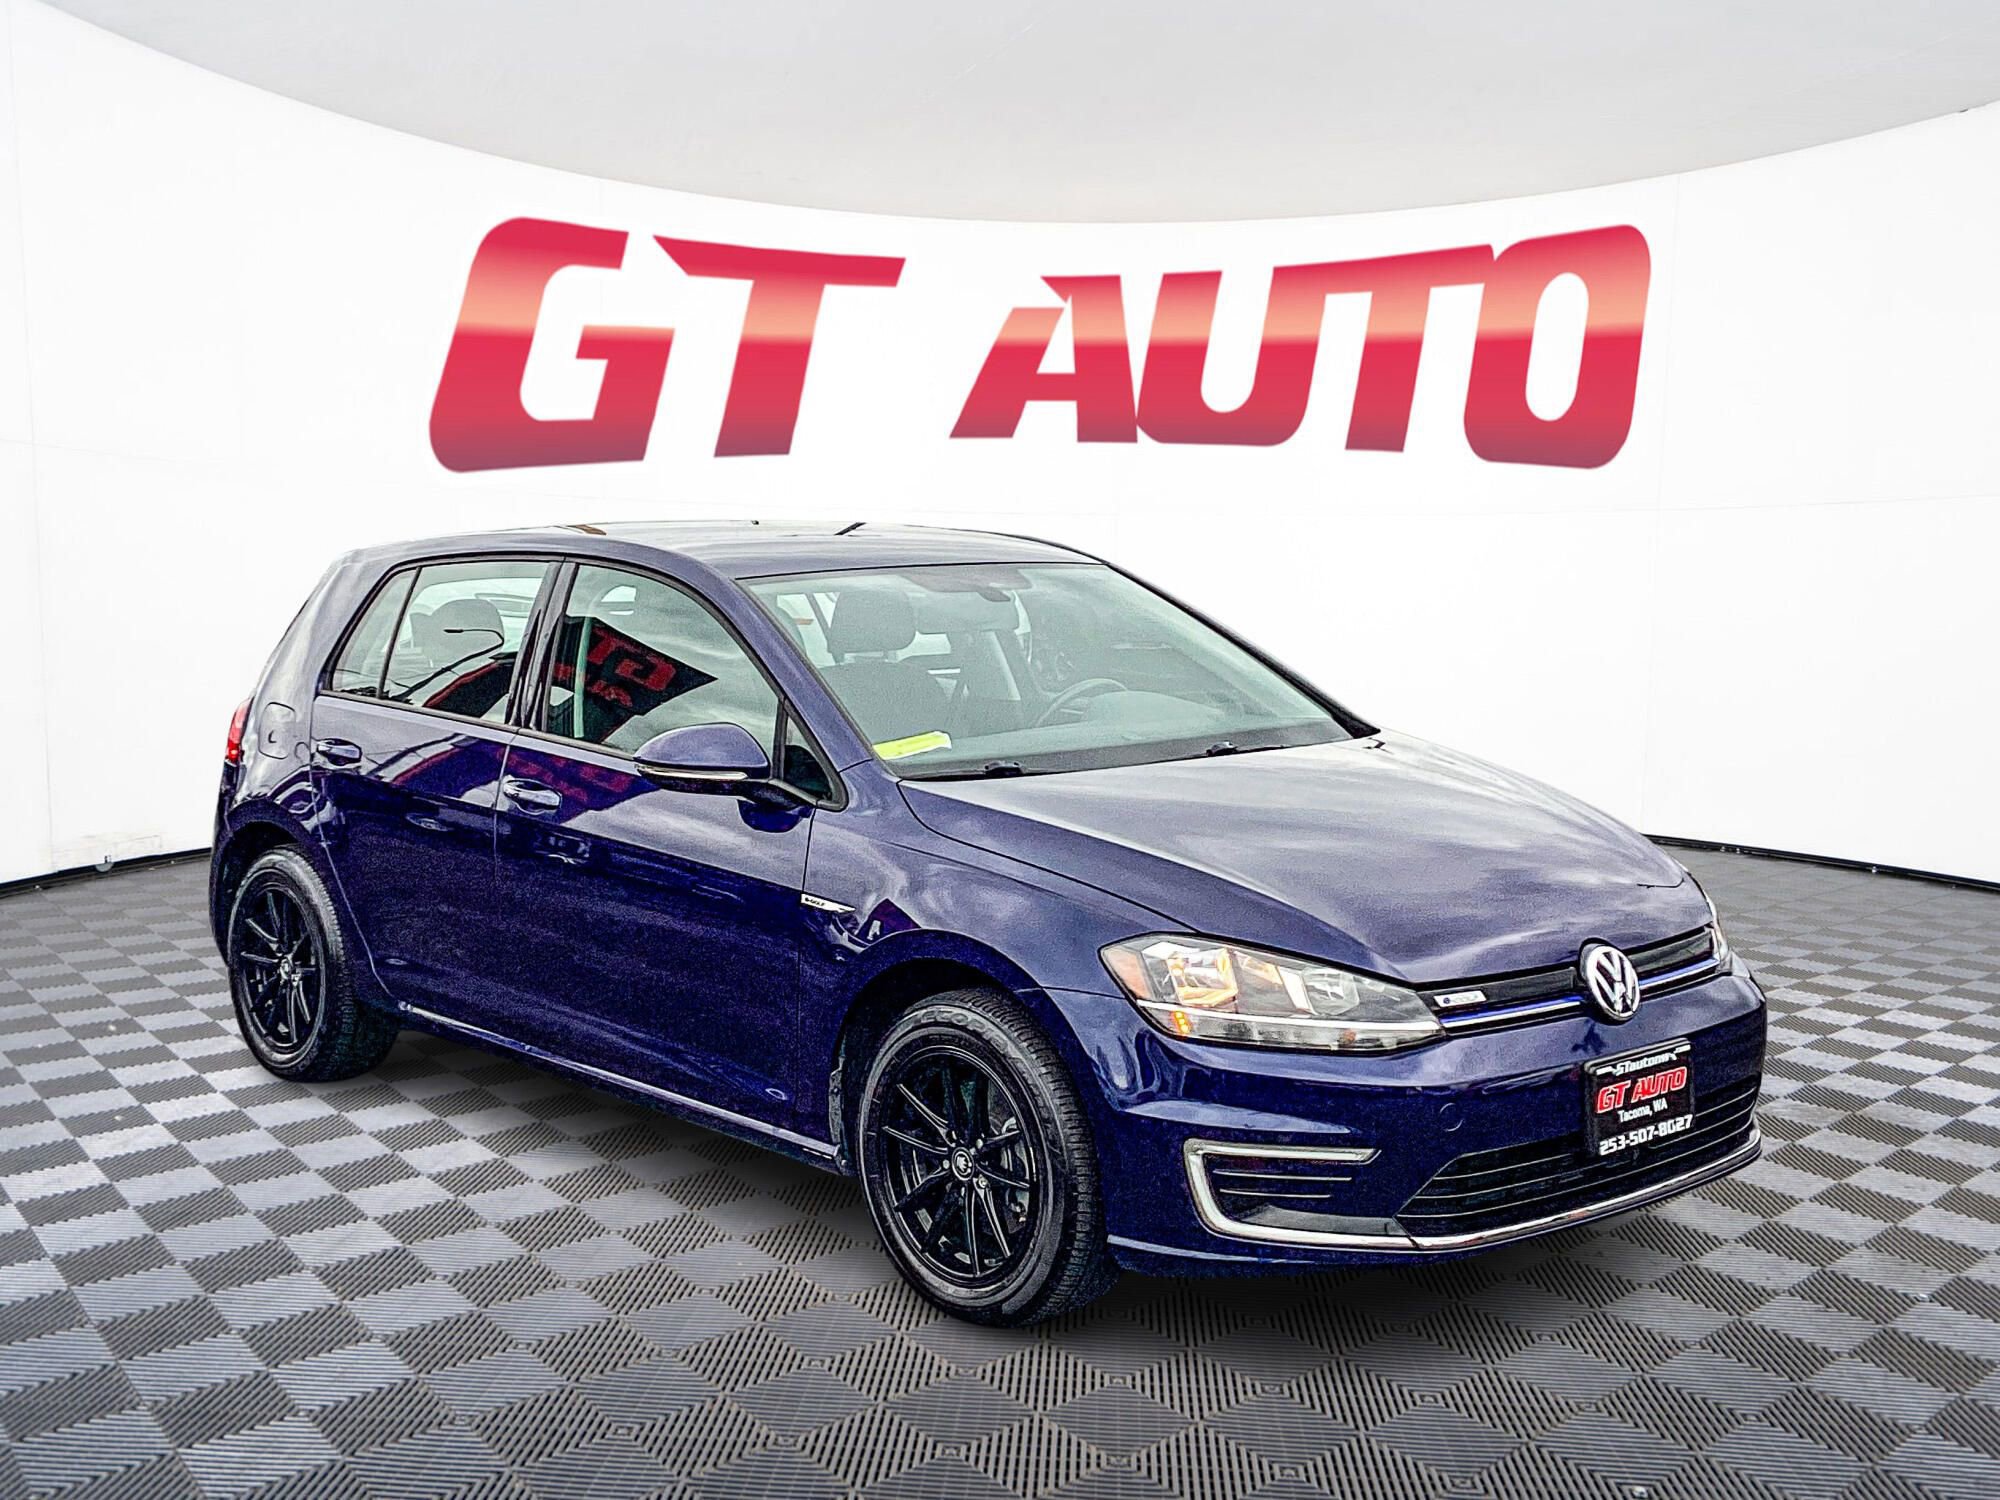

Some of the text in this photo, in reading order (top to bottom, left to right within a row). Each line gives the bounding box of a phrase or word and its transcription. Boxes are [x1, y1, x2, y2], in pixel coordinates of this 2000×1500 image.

[429, 217, 1651, 472] GT AUTO
[1596, 1066, 1688, 1114] GT AUTO
[1617, 1097, 1668, 1123] Tacoma, WA
[1599, 1114, 1693, 1156] 253-507-8027
